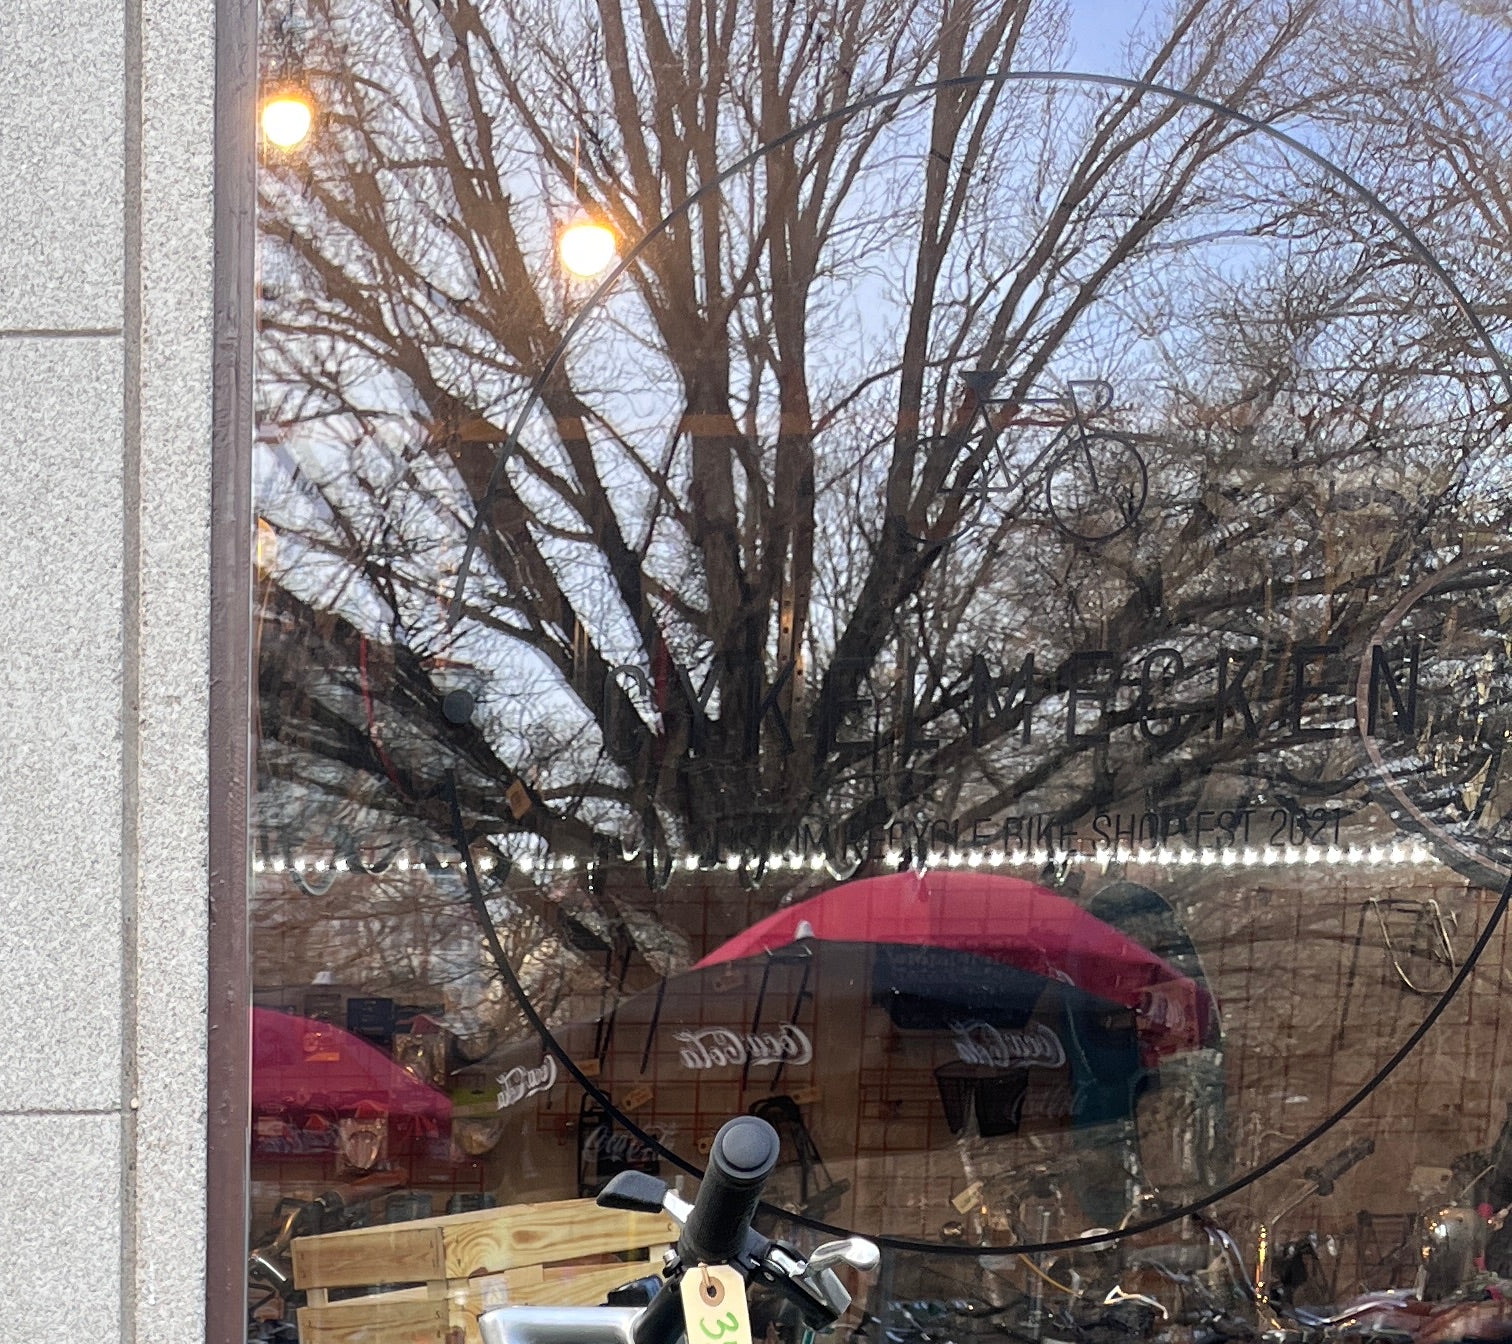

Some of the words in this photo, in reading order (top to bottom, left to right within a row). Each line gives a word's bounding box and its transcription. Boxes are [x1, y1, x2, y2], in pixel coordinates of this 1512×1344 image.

[602, 642, 1420, 760] CYKELMECKEN
[842, 816, 993, 853] RECYCLE
[1003, 815, 1079, 850] BIKE
[1092, 811, 1181, 849] SHOP
[1196, 810, 1255, 848] EST
[1270, 809, 1341, 847] 2021
